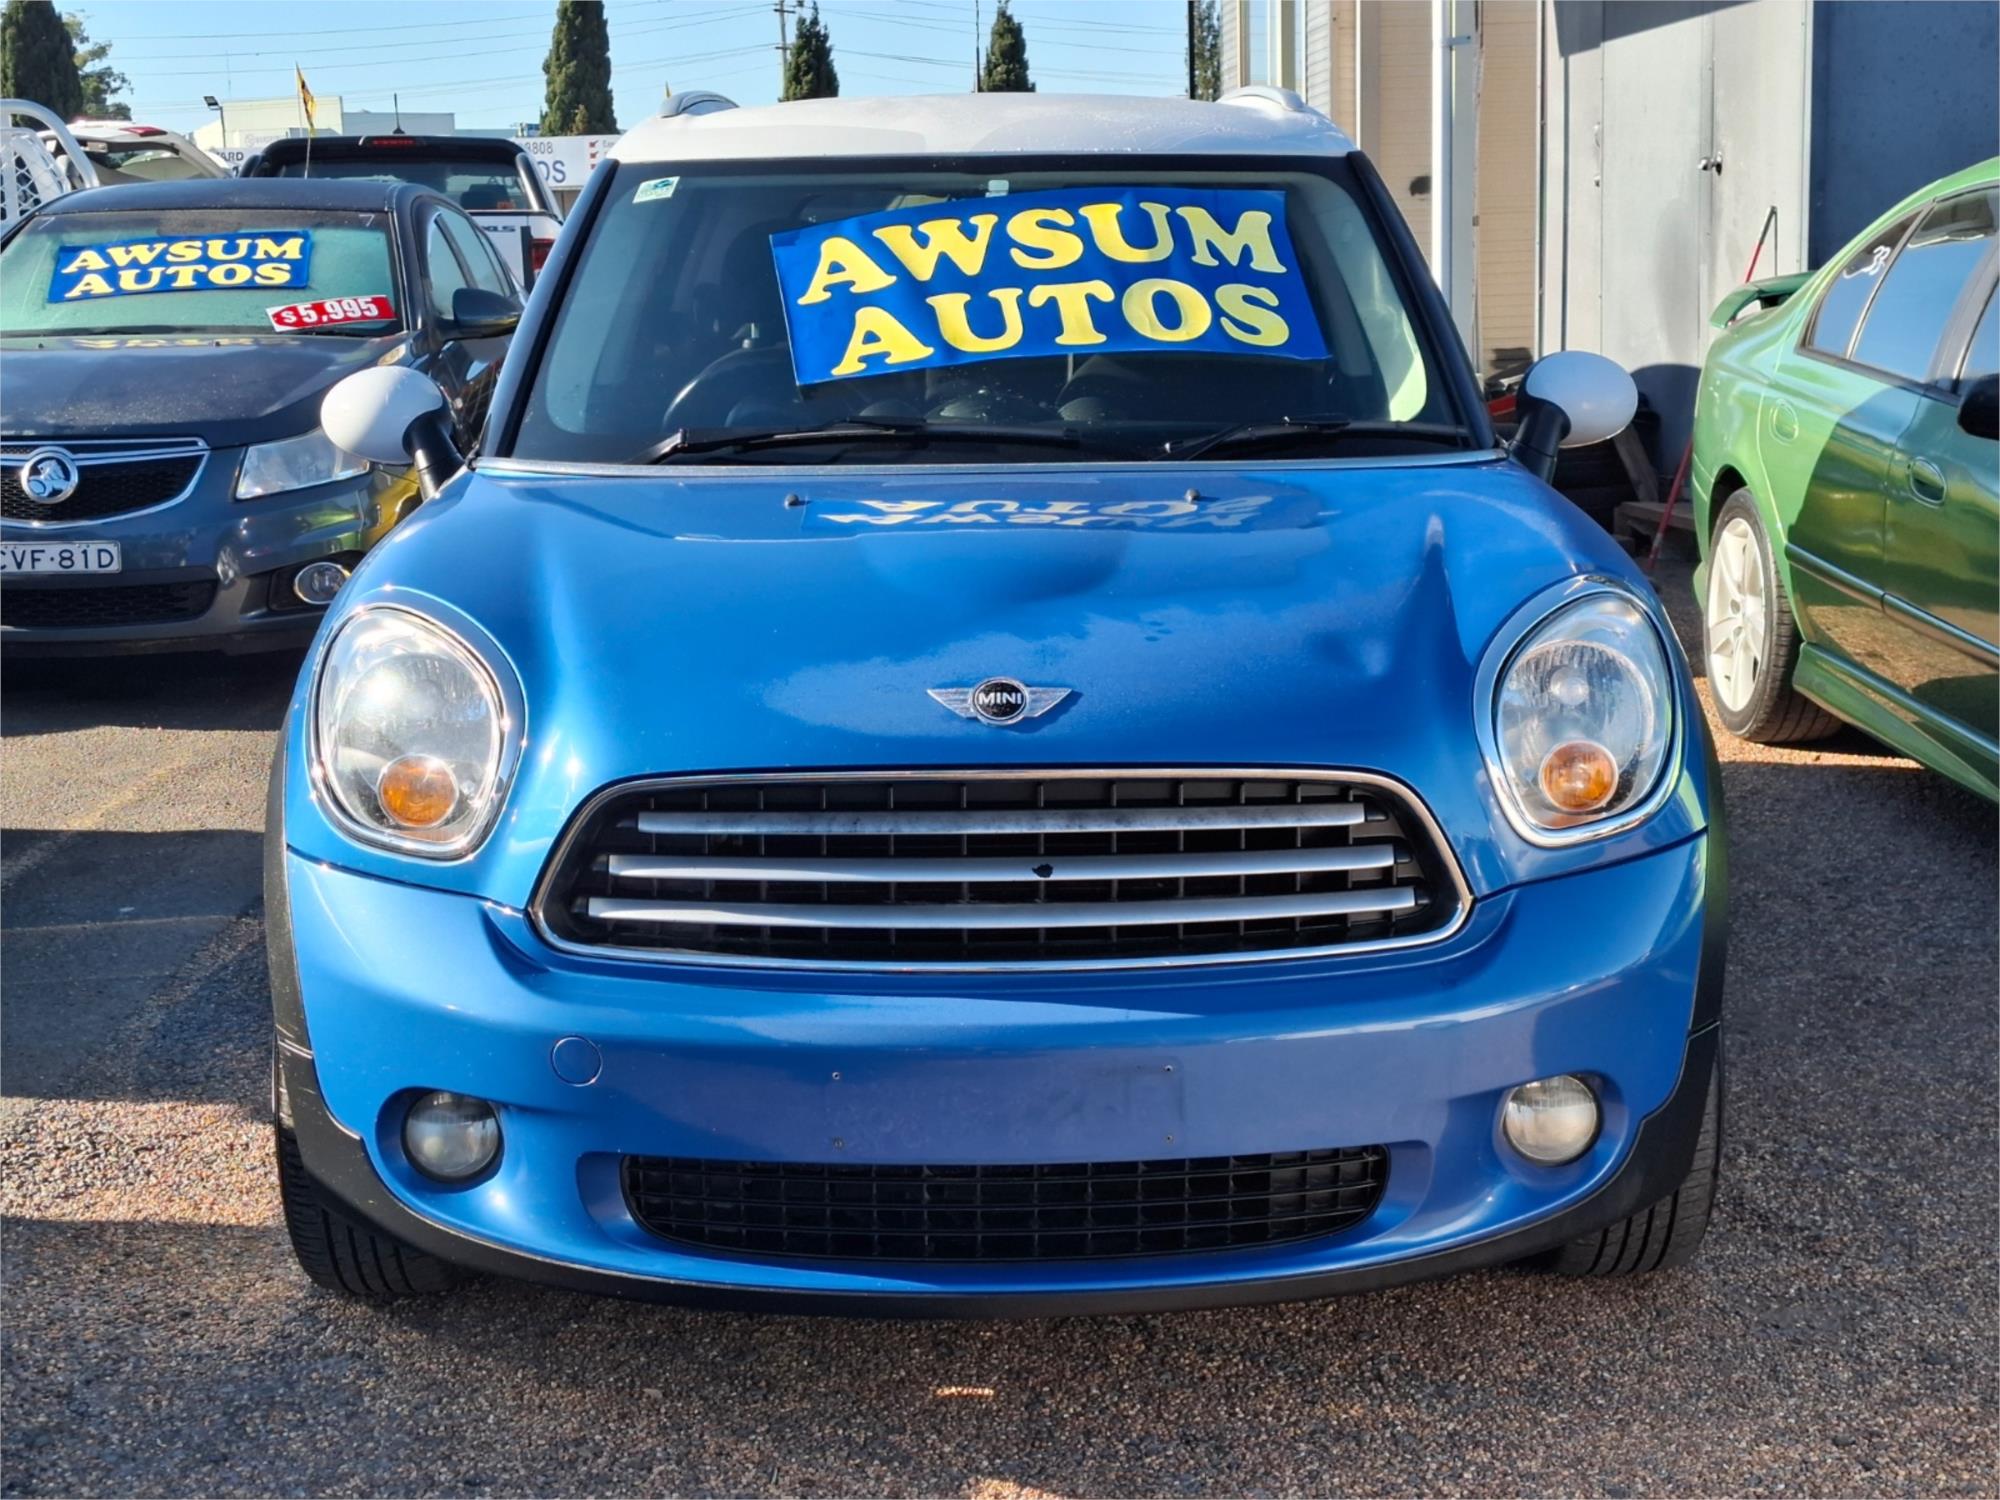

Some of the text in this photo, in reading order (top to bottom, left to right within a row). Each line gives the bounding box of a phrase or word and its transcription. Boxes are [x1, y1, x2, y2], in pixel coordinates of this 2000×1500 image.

[60, 237, 305, 274] AWSUM
[797, 201, 1288, 305] AWSUM
[64, 262, 292, 299] AUTOS
[280, 297, 379, 324] $5,995
[830, 277, 1291, 376] AUTOS
[978, 691, 1022, 705] MINI
